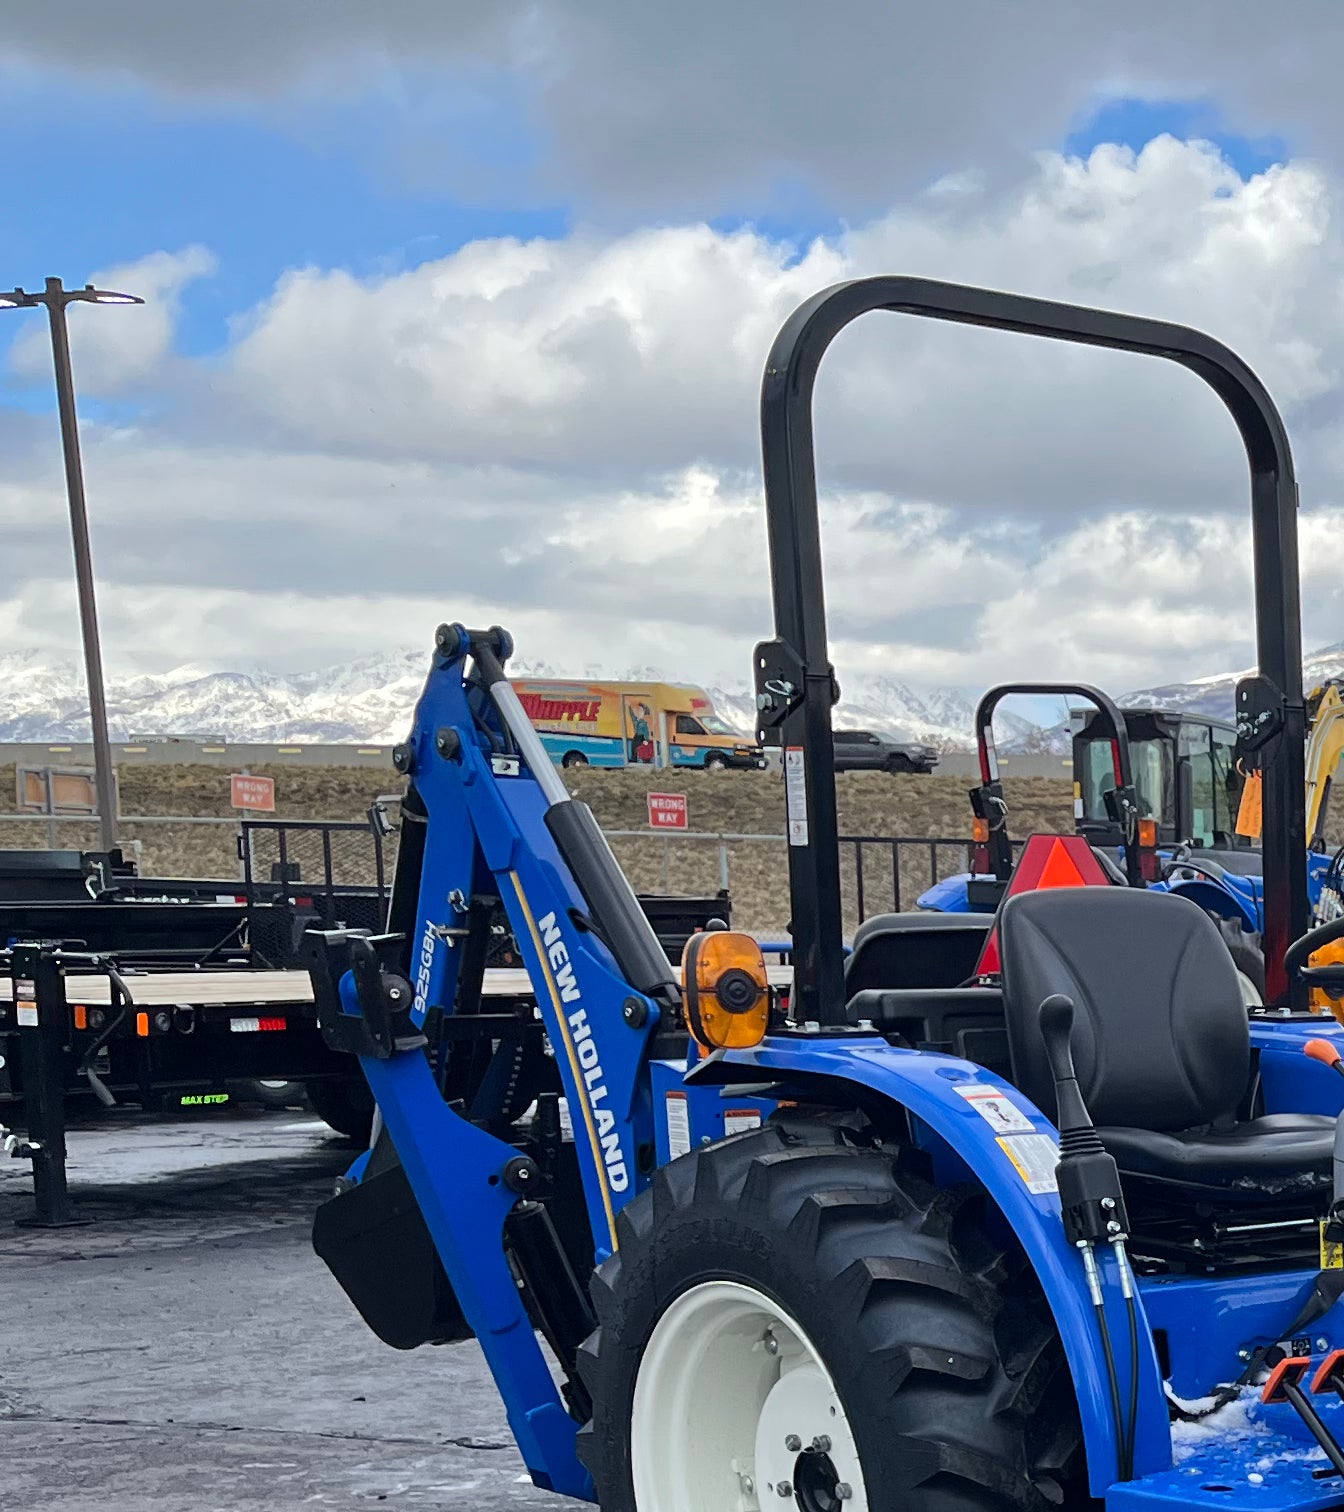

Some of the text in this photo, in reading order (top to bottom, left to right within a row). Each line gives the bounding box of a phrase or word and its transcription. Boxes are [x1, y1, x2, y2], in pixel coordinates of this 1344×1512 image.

[237, 781, 270, 793] WRONG
[243, 793, 263, 804] WAY
[651, 798, 684, 810] WRONG
[658, 812, 678, 823] WAY
[414, 920, 436, 1014] 925GBH
[539, 911, 629, 1192] NEW HOLLAND
[180, 1095, 203, 1105] MAX
